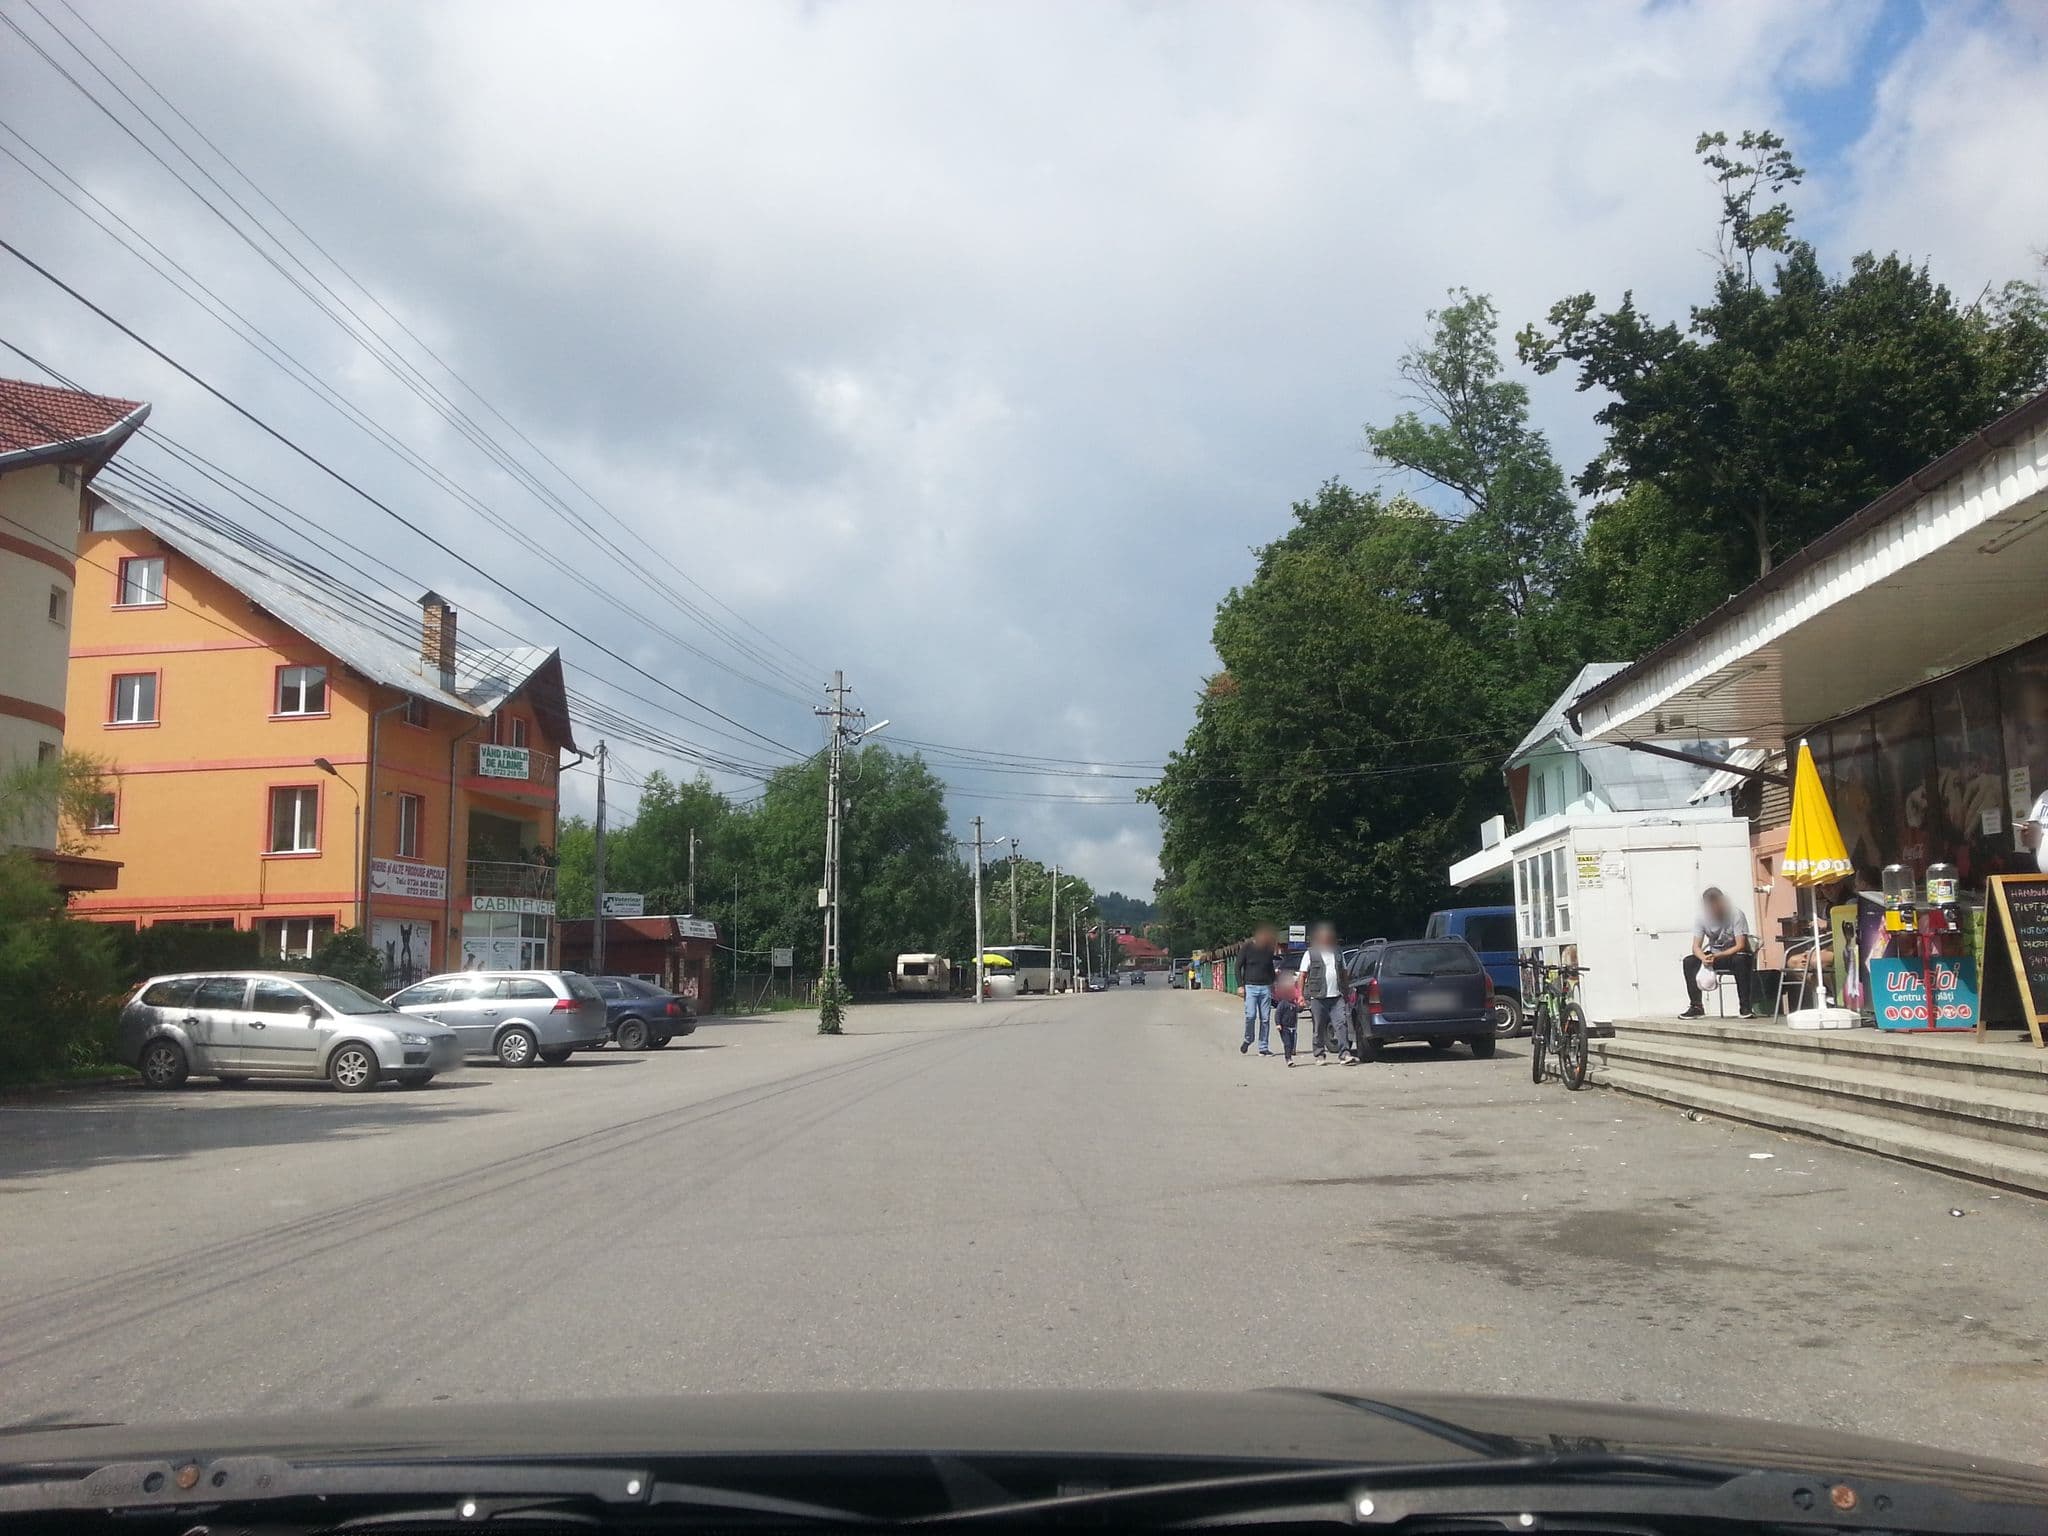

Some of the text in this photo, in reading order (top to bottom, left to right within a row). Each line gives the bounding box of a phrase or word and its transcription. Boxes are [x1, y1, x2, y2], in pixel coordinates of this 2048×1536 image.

[486, 758, 496, 768] DE
[474, 897, 533, 913] CABINET
[1886, 962, 1961, 992] un-doi
[1892, 992, 1921, 1002] Centru
